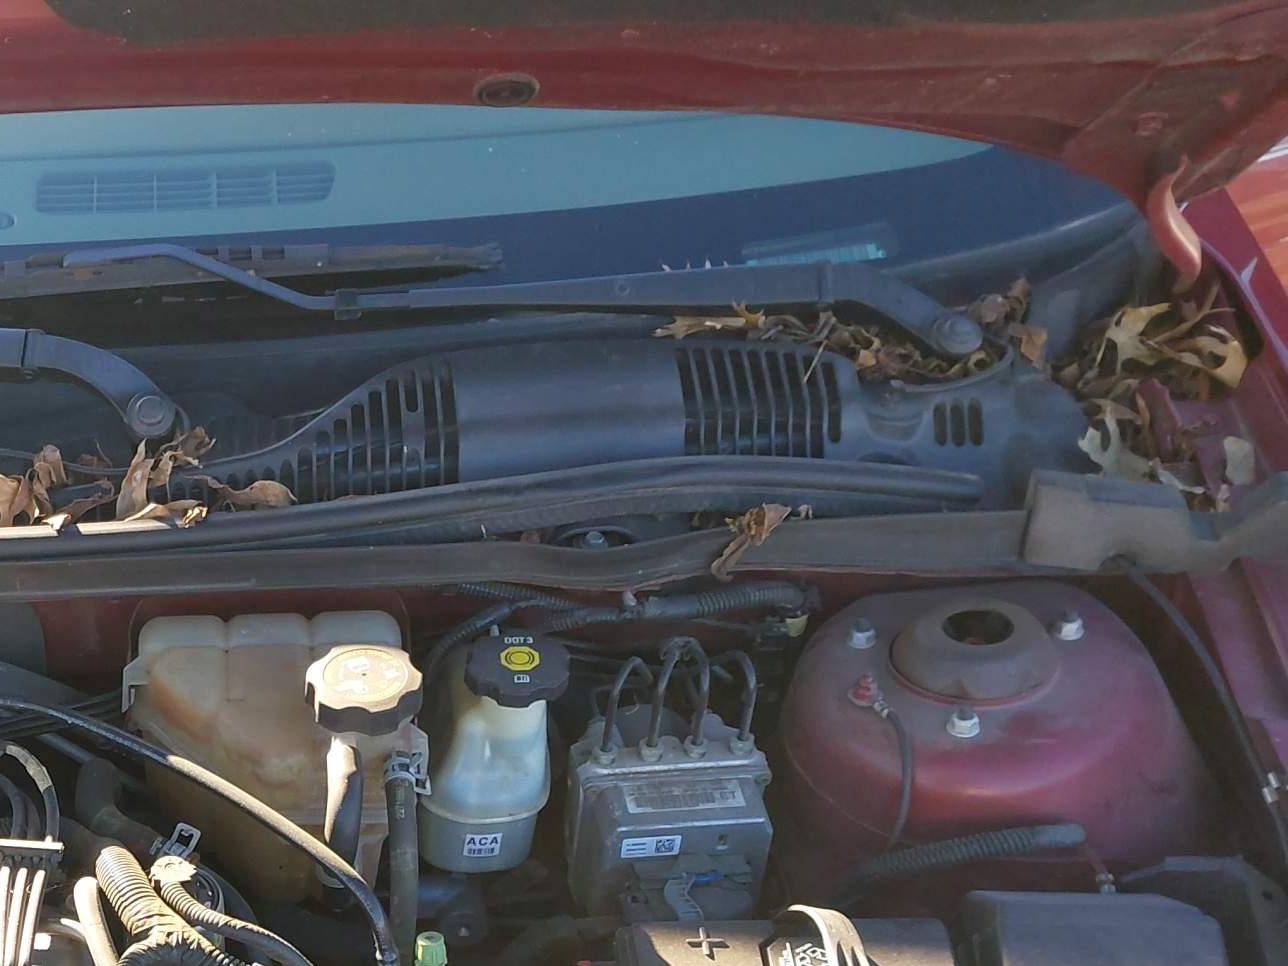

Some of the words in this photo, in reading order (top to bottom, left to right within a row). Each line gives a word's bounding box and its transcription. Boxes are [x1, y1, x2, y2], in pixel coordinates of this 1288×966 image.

[503, 636, 525, 645] DOT
[526, 636, 534, 645] 3
[466, 835, 500, 847] ACA
